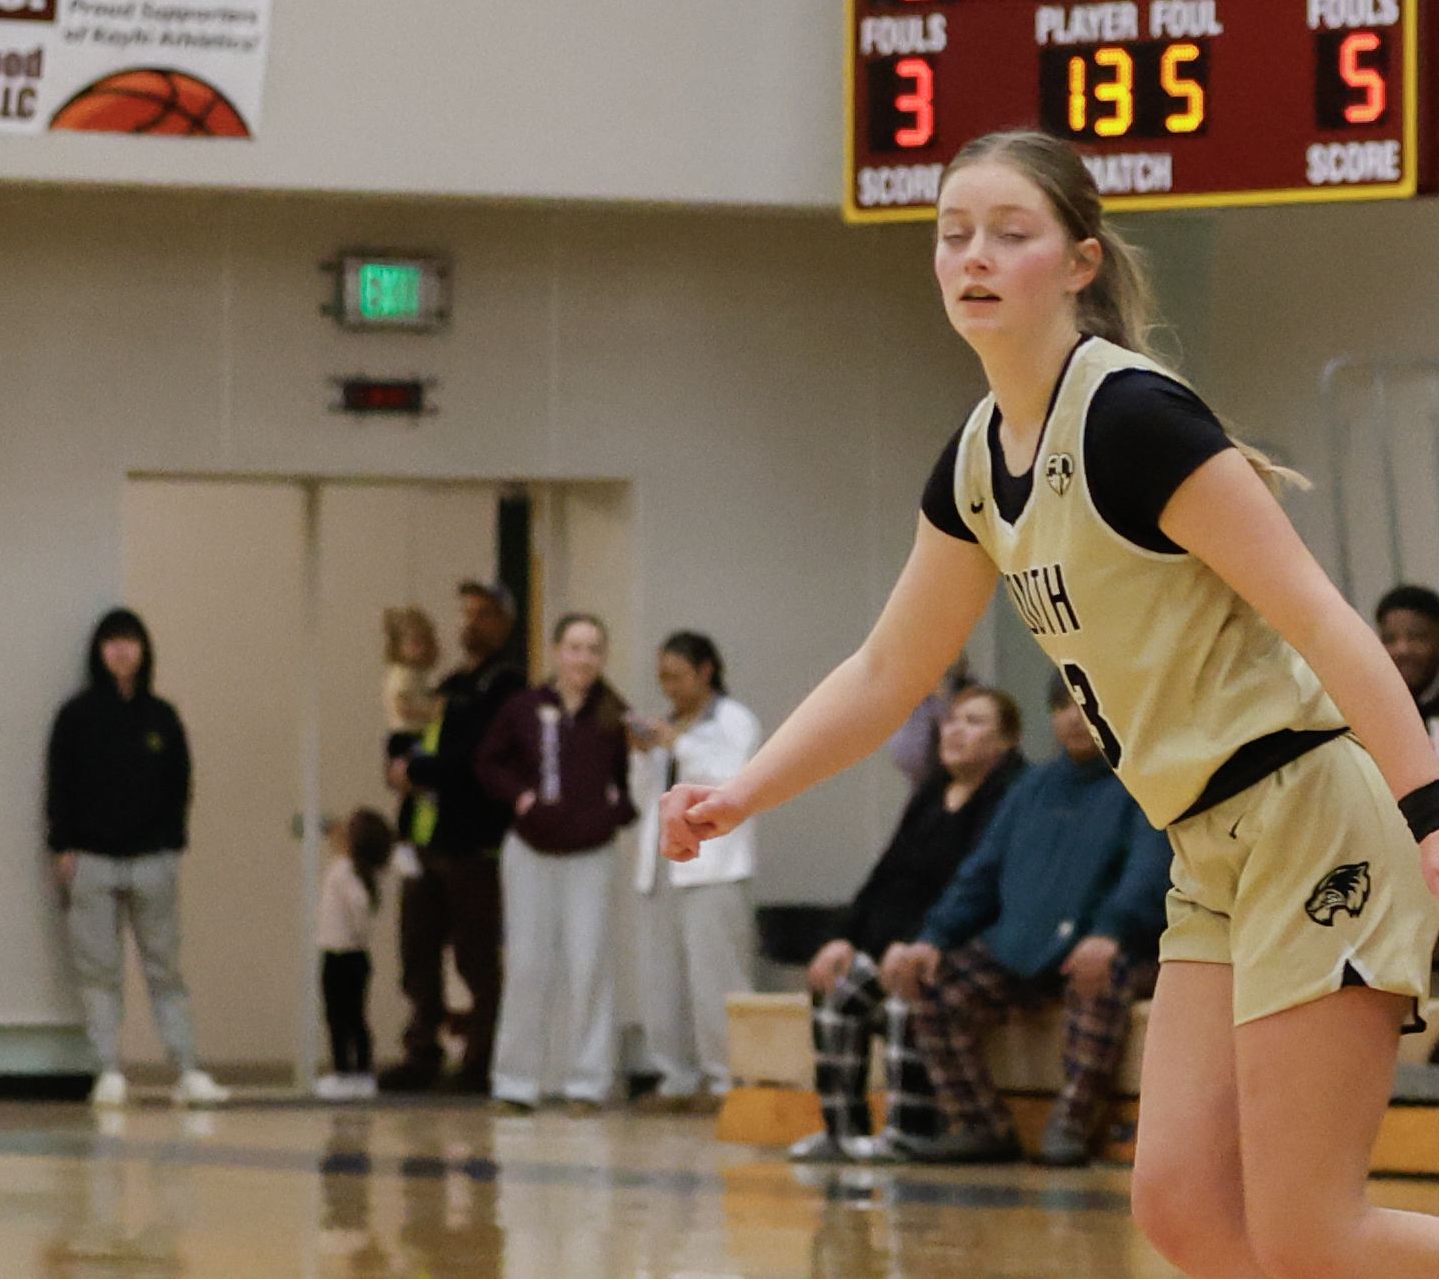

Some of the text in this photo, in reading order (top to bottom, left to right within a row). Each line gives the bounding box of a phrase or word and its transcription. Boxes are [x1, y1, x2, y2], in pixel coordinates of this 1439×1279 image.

[861, 13, 947, 56] FOULS
[1035, 2, 1138, 46] PLAYER
[894, 58, 934, 148] 3
[1161, 43, 1206, 134] 5
[1338, 33, 1386, 124] 5
[1306, 141, 1401, 184] SCORE
